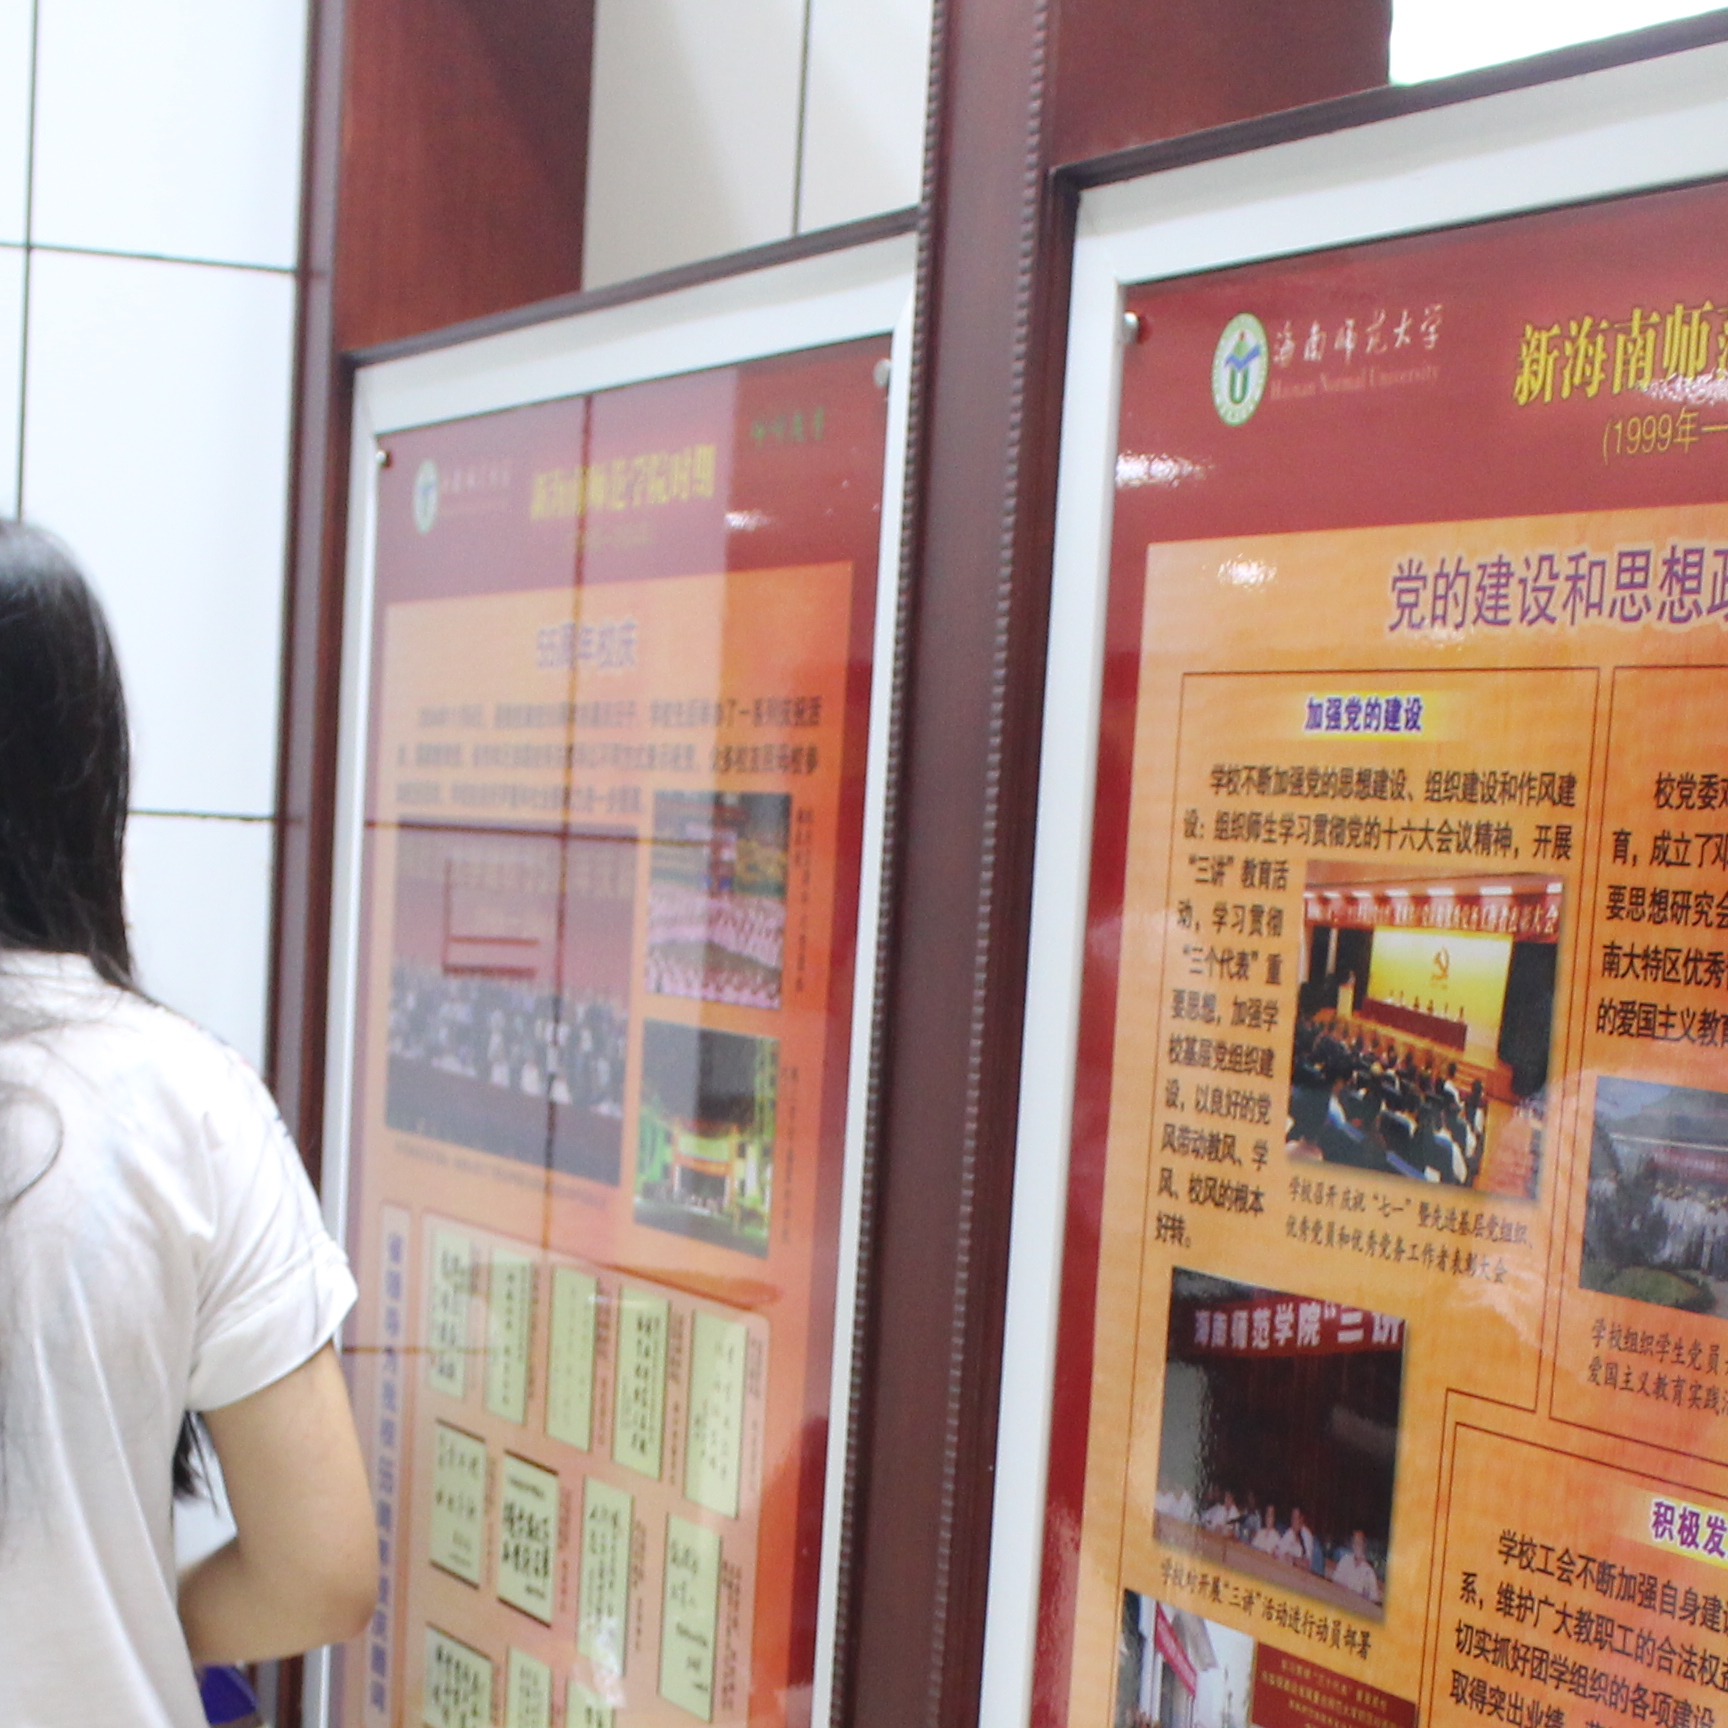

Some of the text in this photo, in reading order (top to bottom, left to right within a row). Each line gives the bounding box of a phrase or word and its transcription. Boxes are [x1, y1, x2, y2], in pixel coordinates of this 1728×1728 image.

[1303, 694, 1423, 734] 加强党的建设
